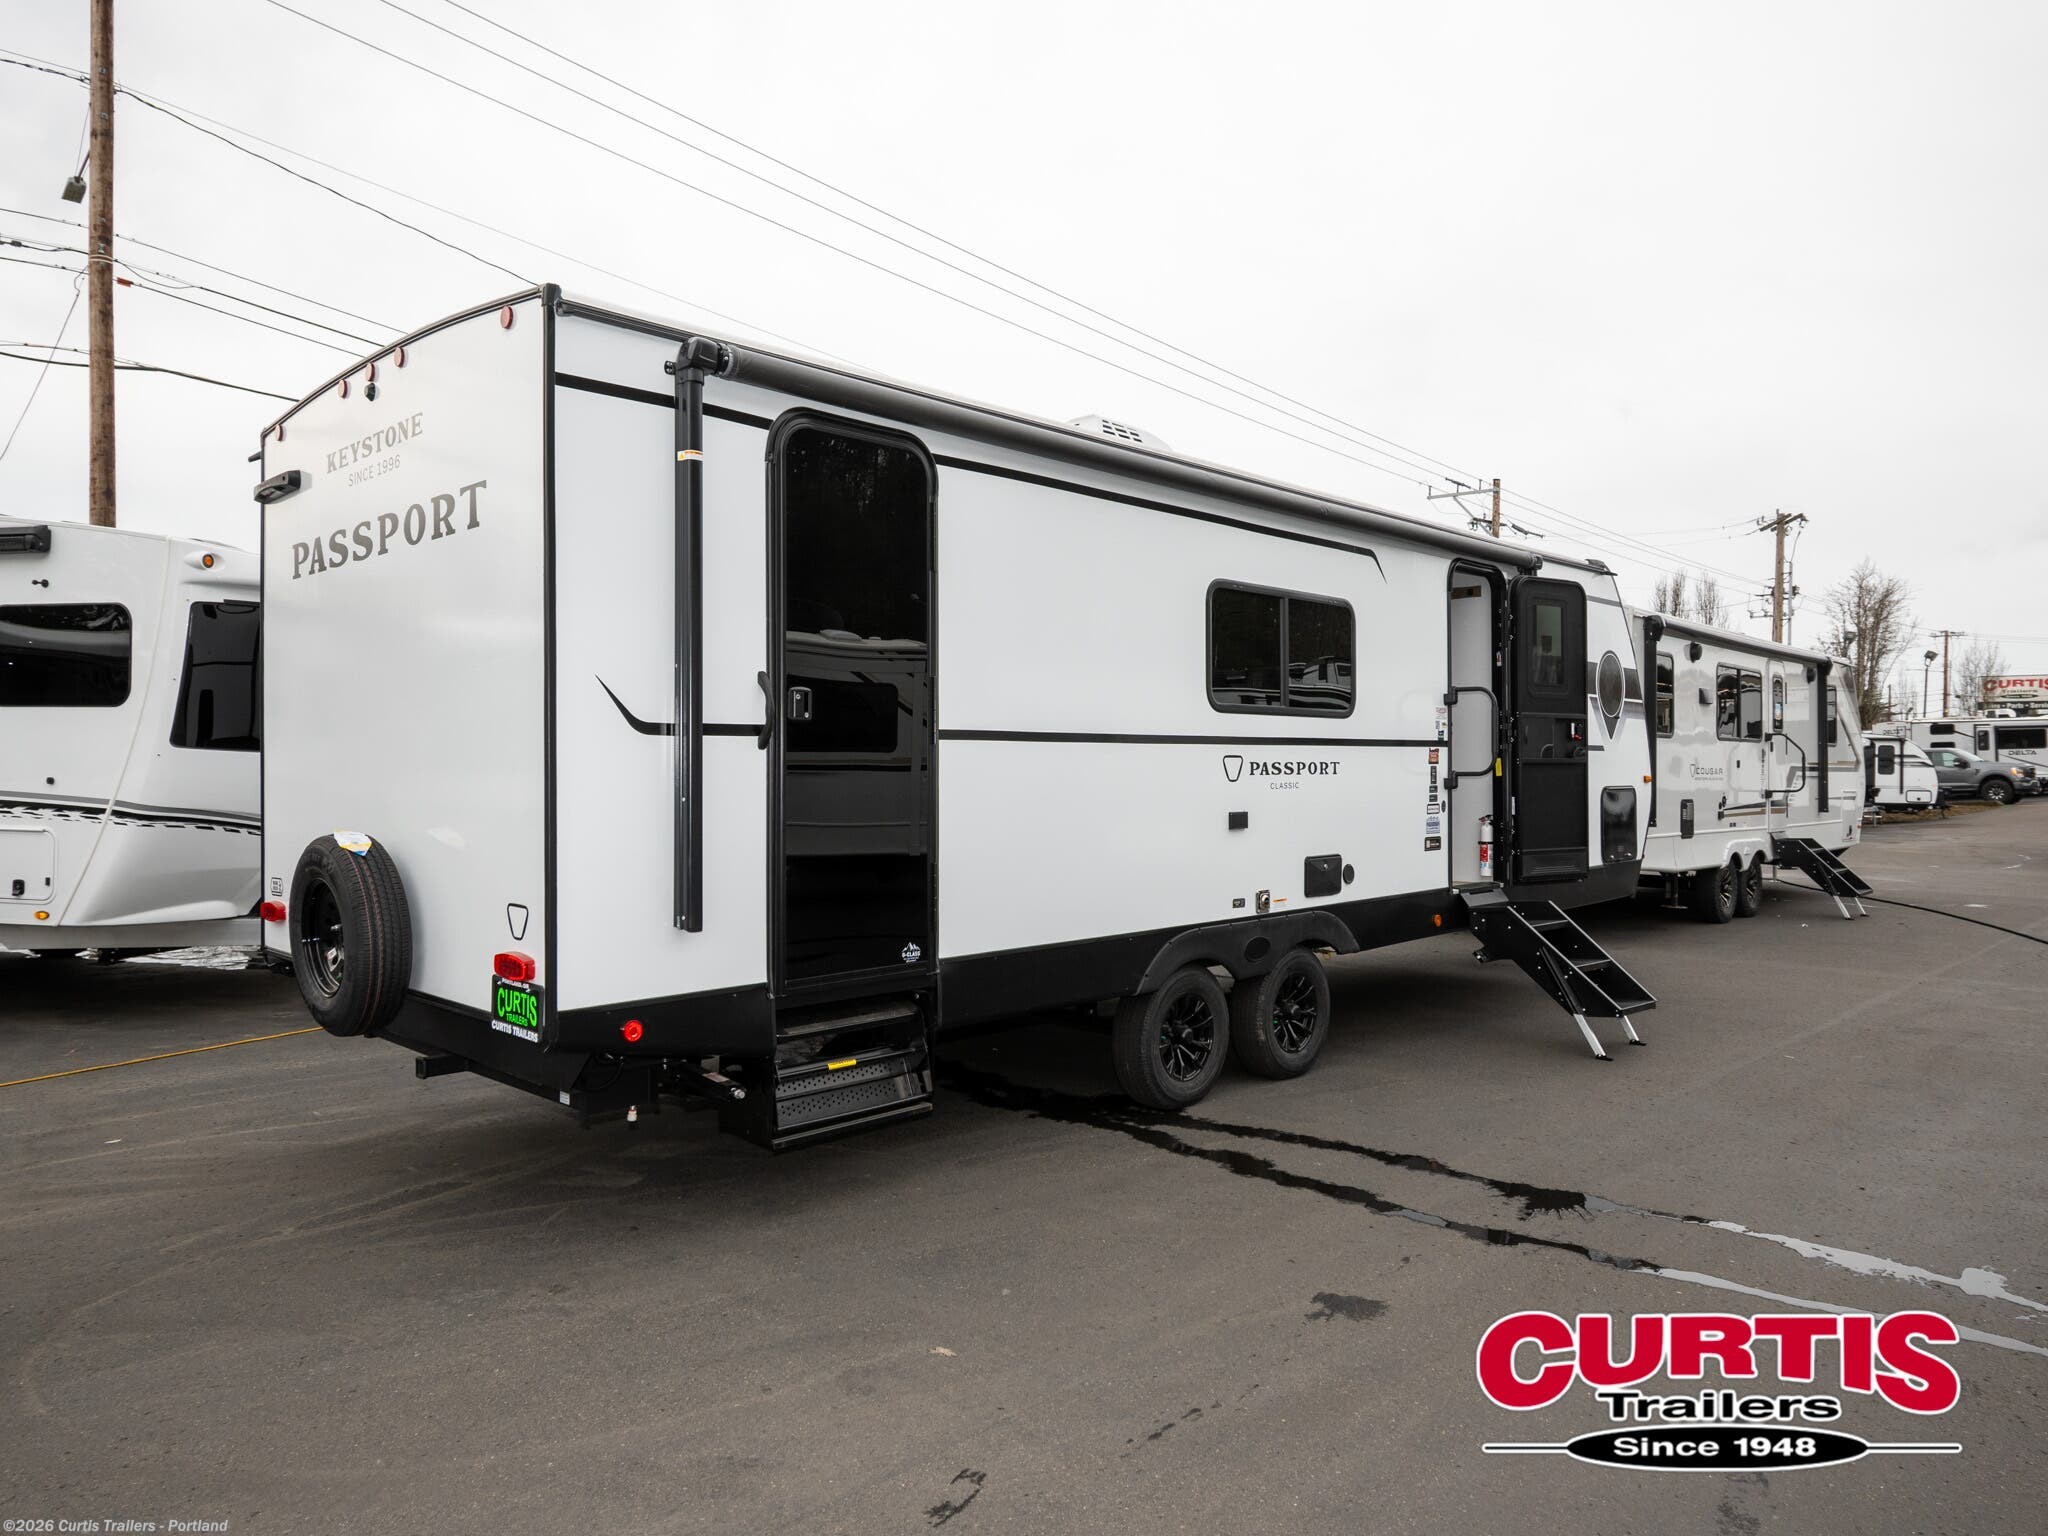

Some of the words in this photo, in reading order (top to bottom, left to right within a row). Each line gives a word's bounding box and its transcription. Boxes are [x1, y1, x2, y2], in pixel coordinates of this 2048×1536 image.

[326, 412, 424, 474] KEYSTONE
[348, 466, 375, 487] SINCE
[377, 454, 400, 477] 1996
[292, 479, 487, 580] PASSPORT
[1249, 761, 1341, 776] PASSPORT
[1695, 767, 1724, 775] COUGAR
[1270, 781, 1300, 790] CLASSIC
[497, 987, 538, 1028] CURTIS
[506, 1012, 529, 1027] TRAILERS
[491, 1020, 512, 1034] CURTIS
[512, 1026, 538, 1043] TRAILERS
